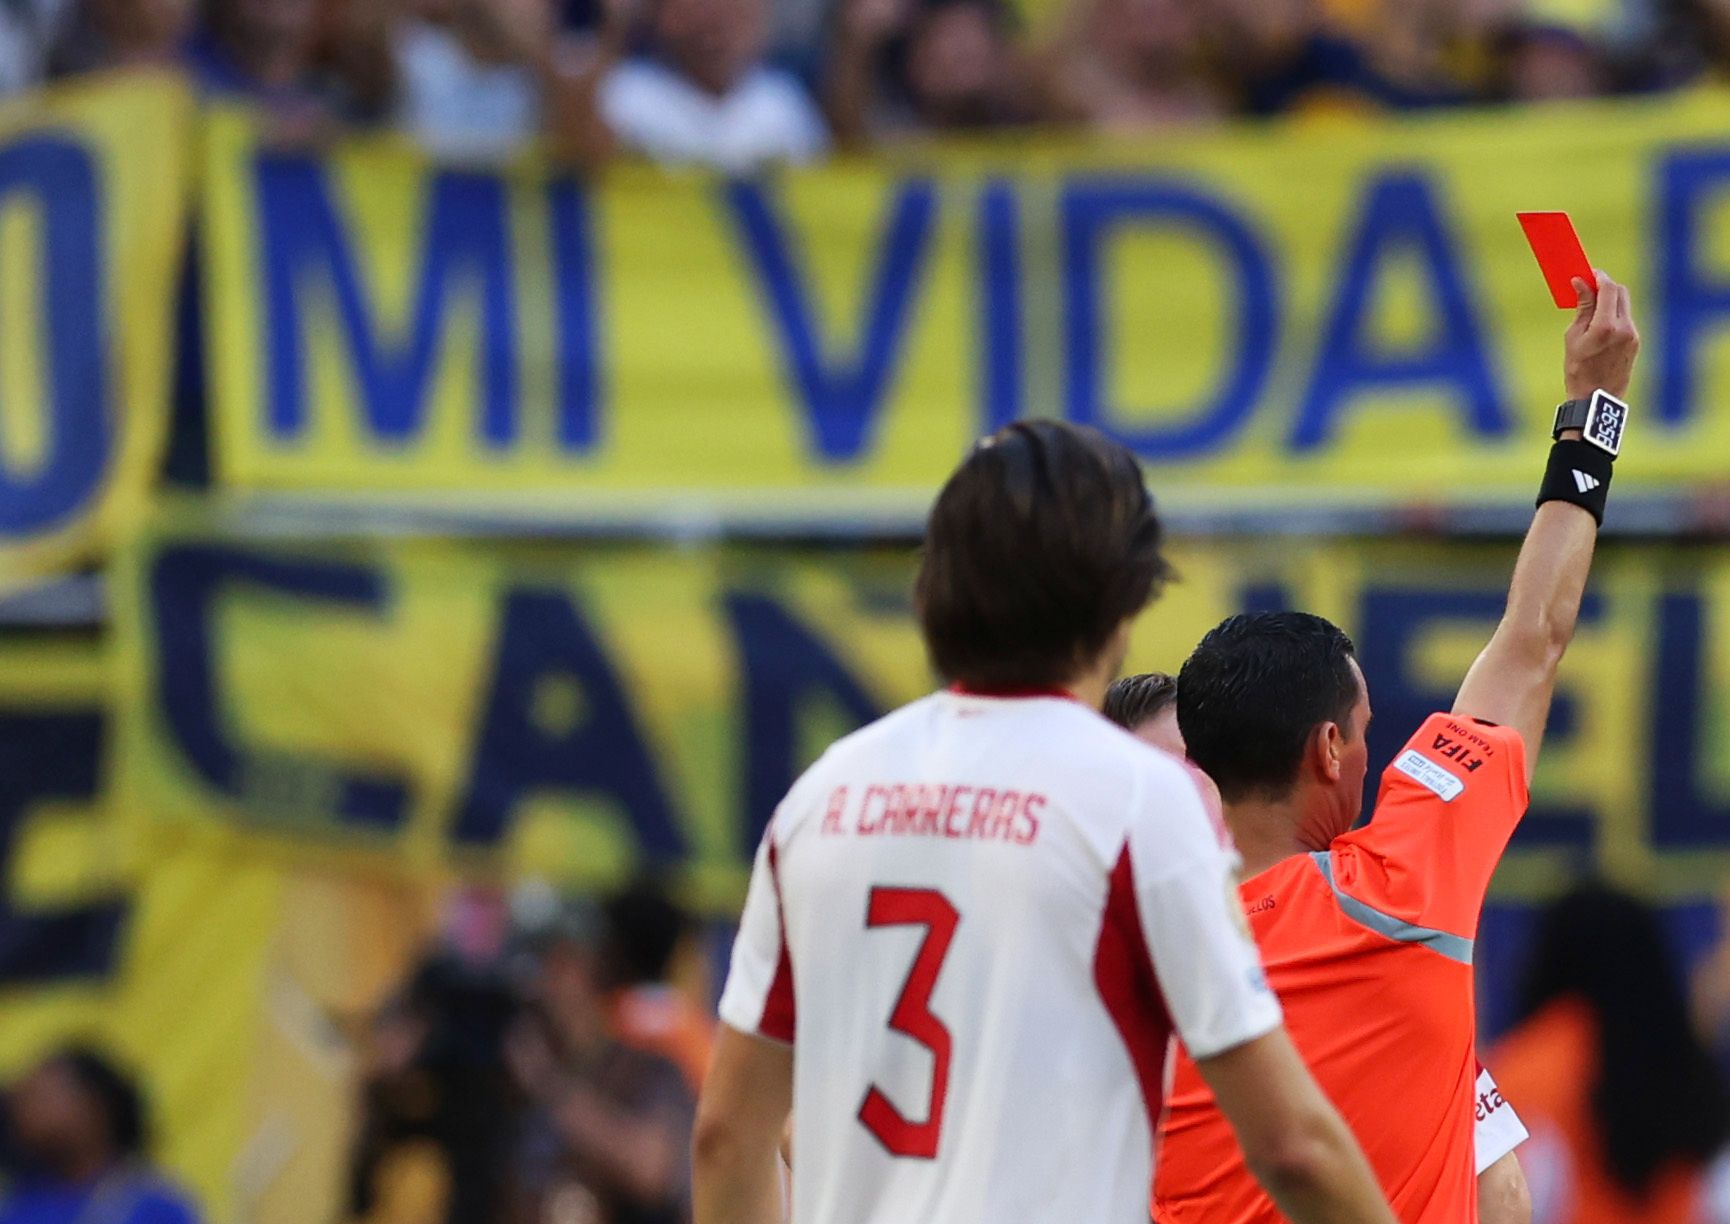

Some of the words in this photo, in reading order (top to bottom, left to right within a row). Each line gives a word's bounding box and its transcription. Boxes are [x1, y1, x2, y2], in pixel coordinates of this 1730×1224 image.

[250, 150, 602, 455] MI
[716, 166, 1512, 466] VIDA
[1431, 732, 1483, 774] FIFA
[1467, 733, 1495, 758] TEAM
[856, 784, 1047, 845] CARRERAS
[857, 885, 961, 1160] 3
